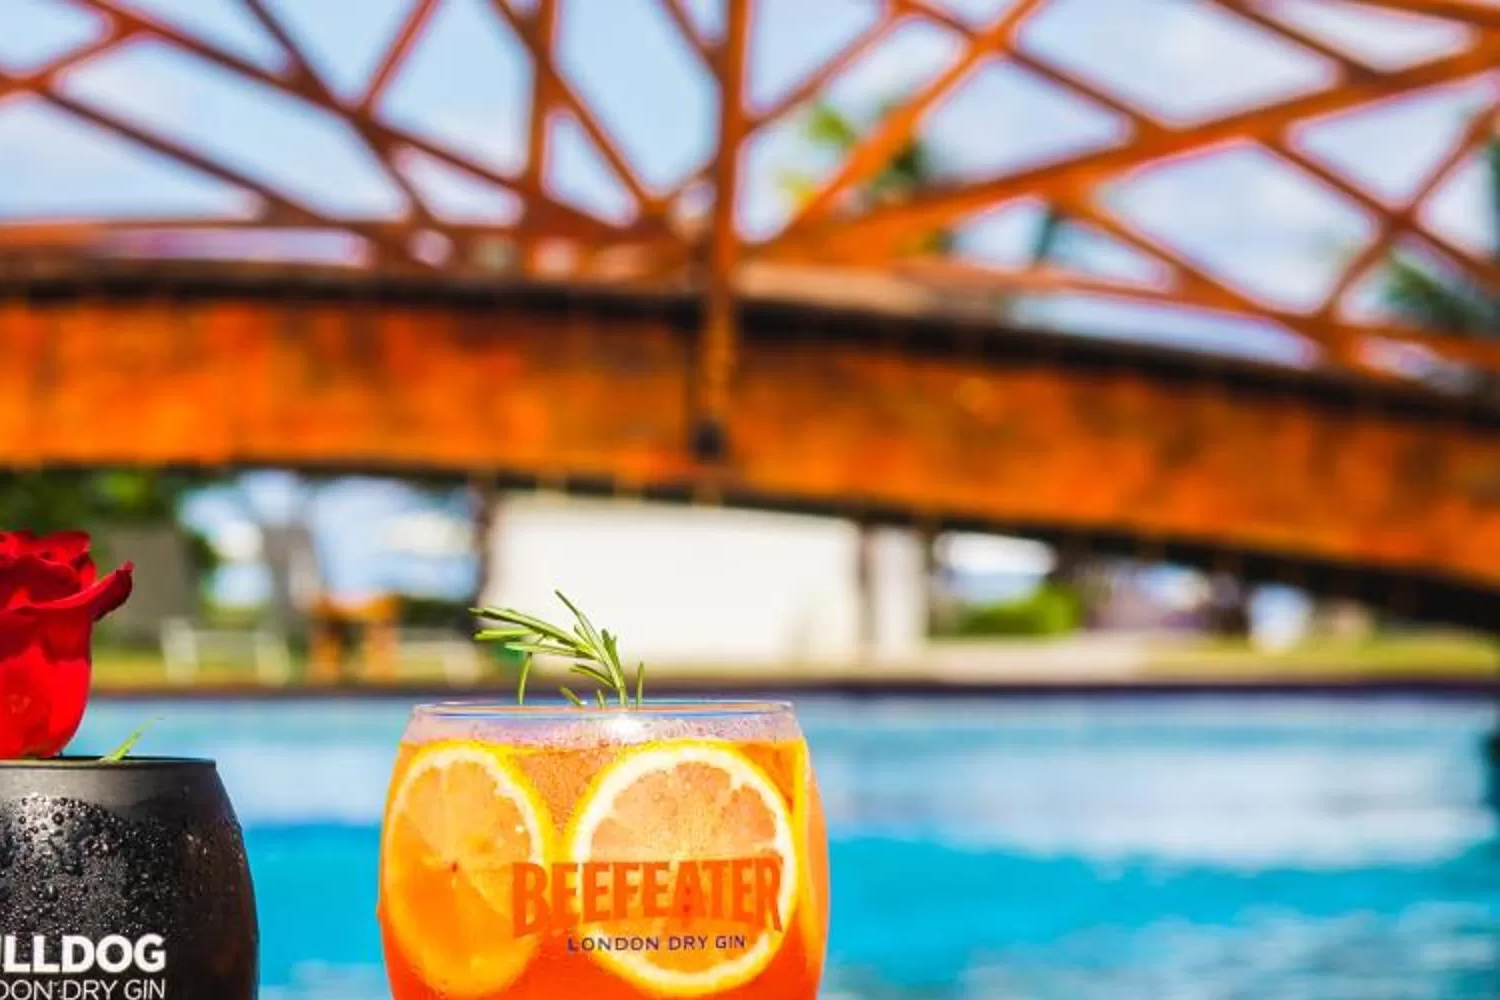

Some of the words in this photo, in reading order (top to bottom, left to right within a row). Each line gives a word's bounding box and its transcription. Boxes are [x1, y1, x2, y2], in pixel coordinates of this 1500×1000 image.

[512, 857, 783, 938] BEEFEATER
[567, 936, 660, 952] LONDON
[668, 936, 709, 950] DRY
[715, 935, 746, 949] GIN
[62, 979, 118, 1000] DRY
[124, 979, 166, 1000] GIN
